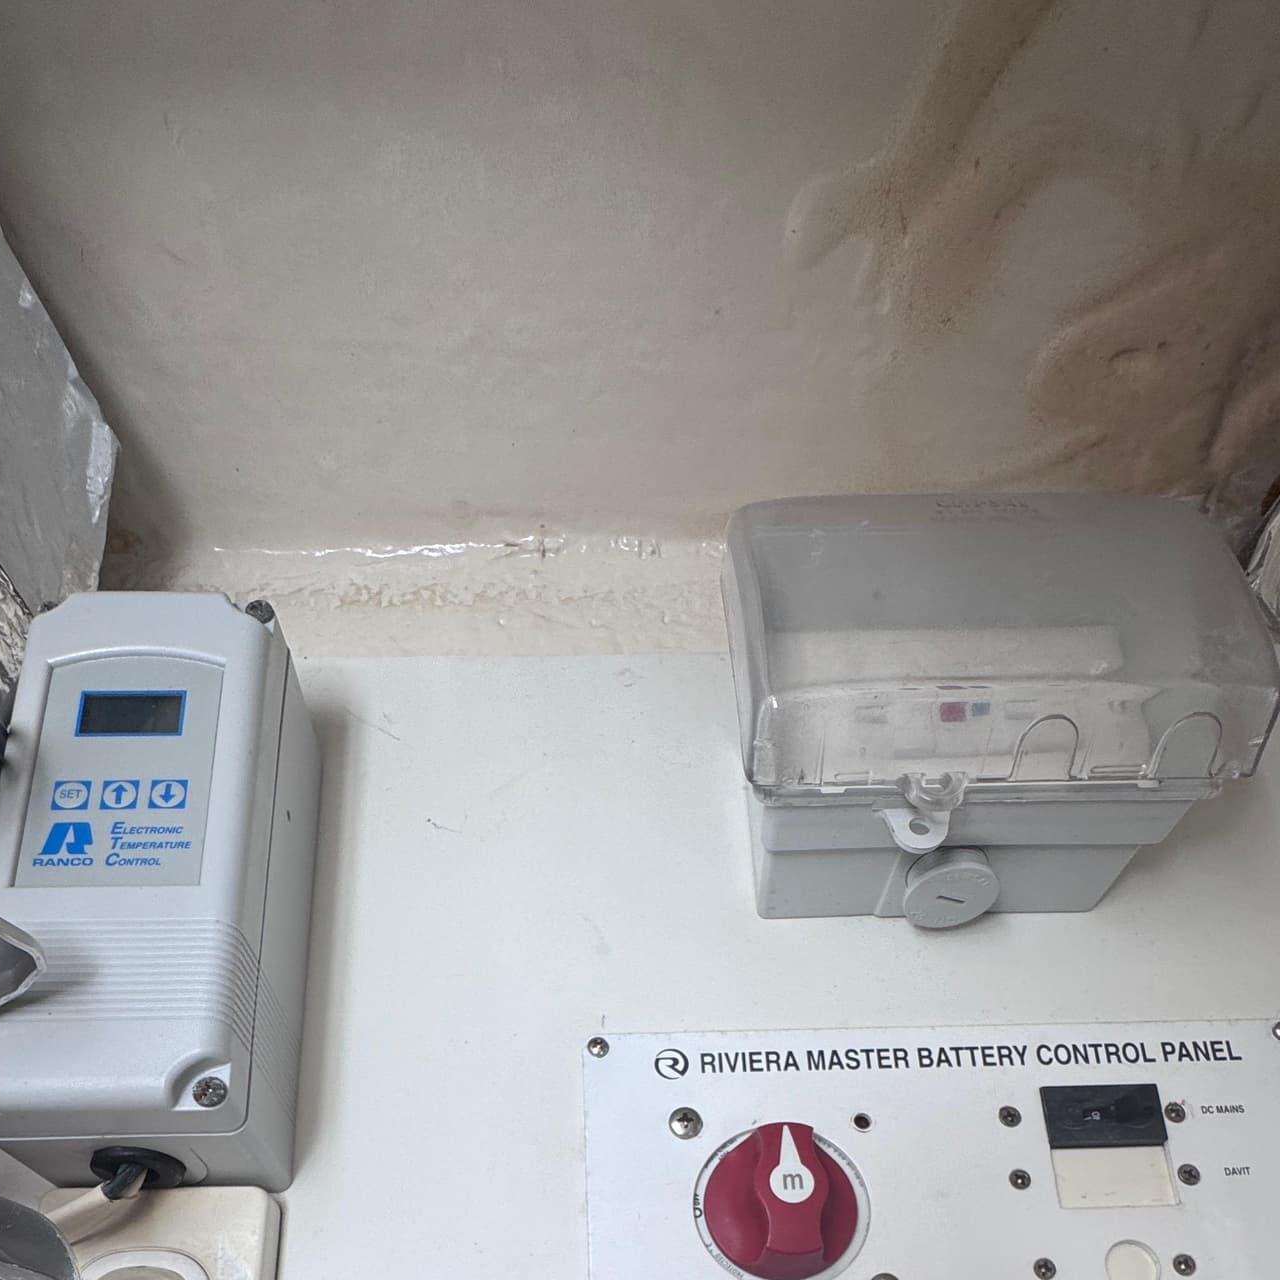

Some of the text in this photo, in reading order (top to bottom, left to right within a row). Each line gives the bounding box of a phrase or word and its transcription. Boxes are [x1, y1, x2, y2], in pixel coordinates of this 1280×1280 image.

[59, 789, 83, 799] SET
[110, 821, 184, 835] ELECTRONIC
[110, 836, 192, 850] TEMPERATURE
[32, 857, 93, 867] RANCO
[105, 853, 161, 866] CONTROL
[700, 1040, 1243, 1073] RIVIERA MASTER BATTERY CONTROL PANEL
[1200, 1104, 1245, 1115] DC MAINS
[1224, 1167, 1251, 1177] DAVIT
[782, 1173, 804, 1190] m
